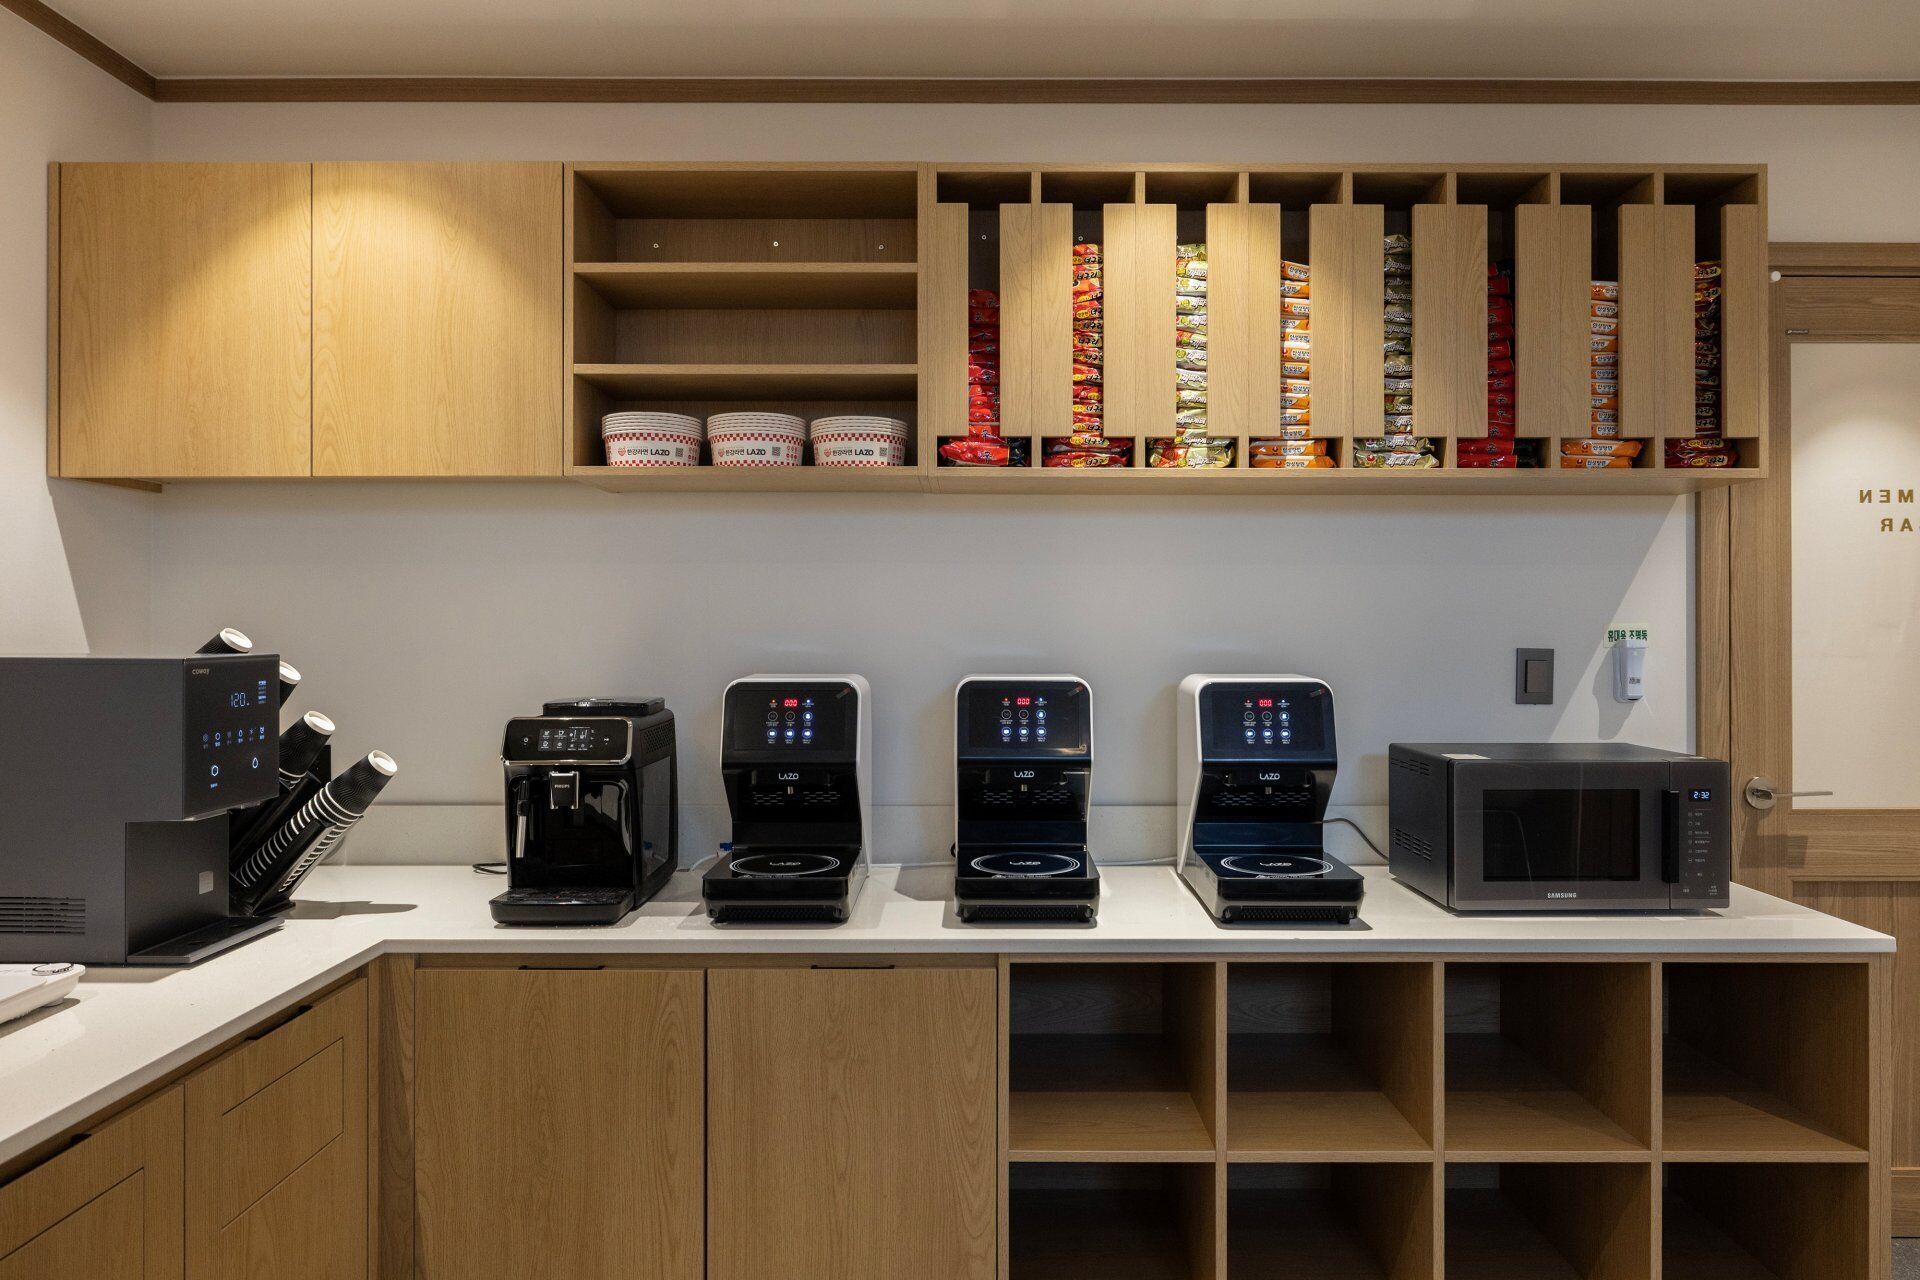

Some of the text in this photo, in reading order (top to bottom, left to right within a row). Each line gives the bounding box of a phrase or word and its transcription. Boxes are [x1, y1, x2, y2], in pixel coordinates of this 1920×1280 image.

[746, 448, 766, 456] LAZO
[854, 448, 874, 456] LAZO
[1608, 630, 1626, 642] 휴대용
[230, 692, 246, 707] 120
[1693, 791, 1710, 799] 2:32
